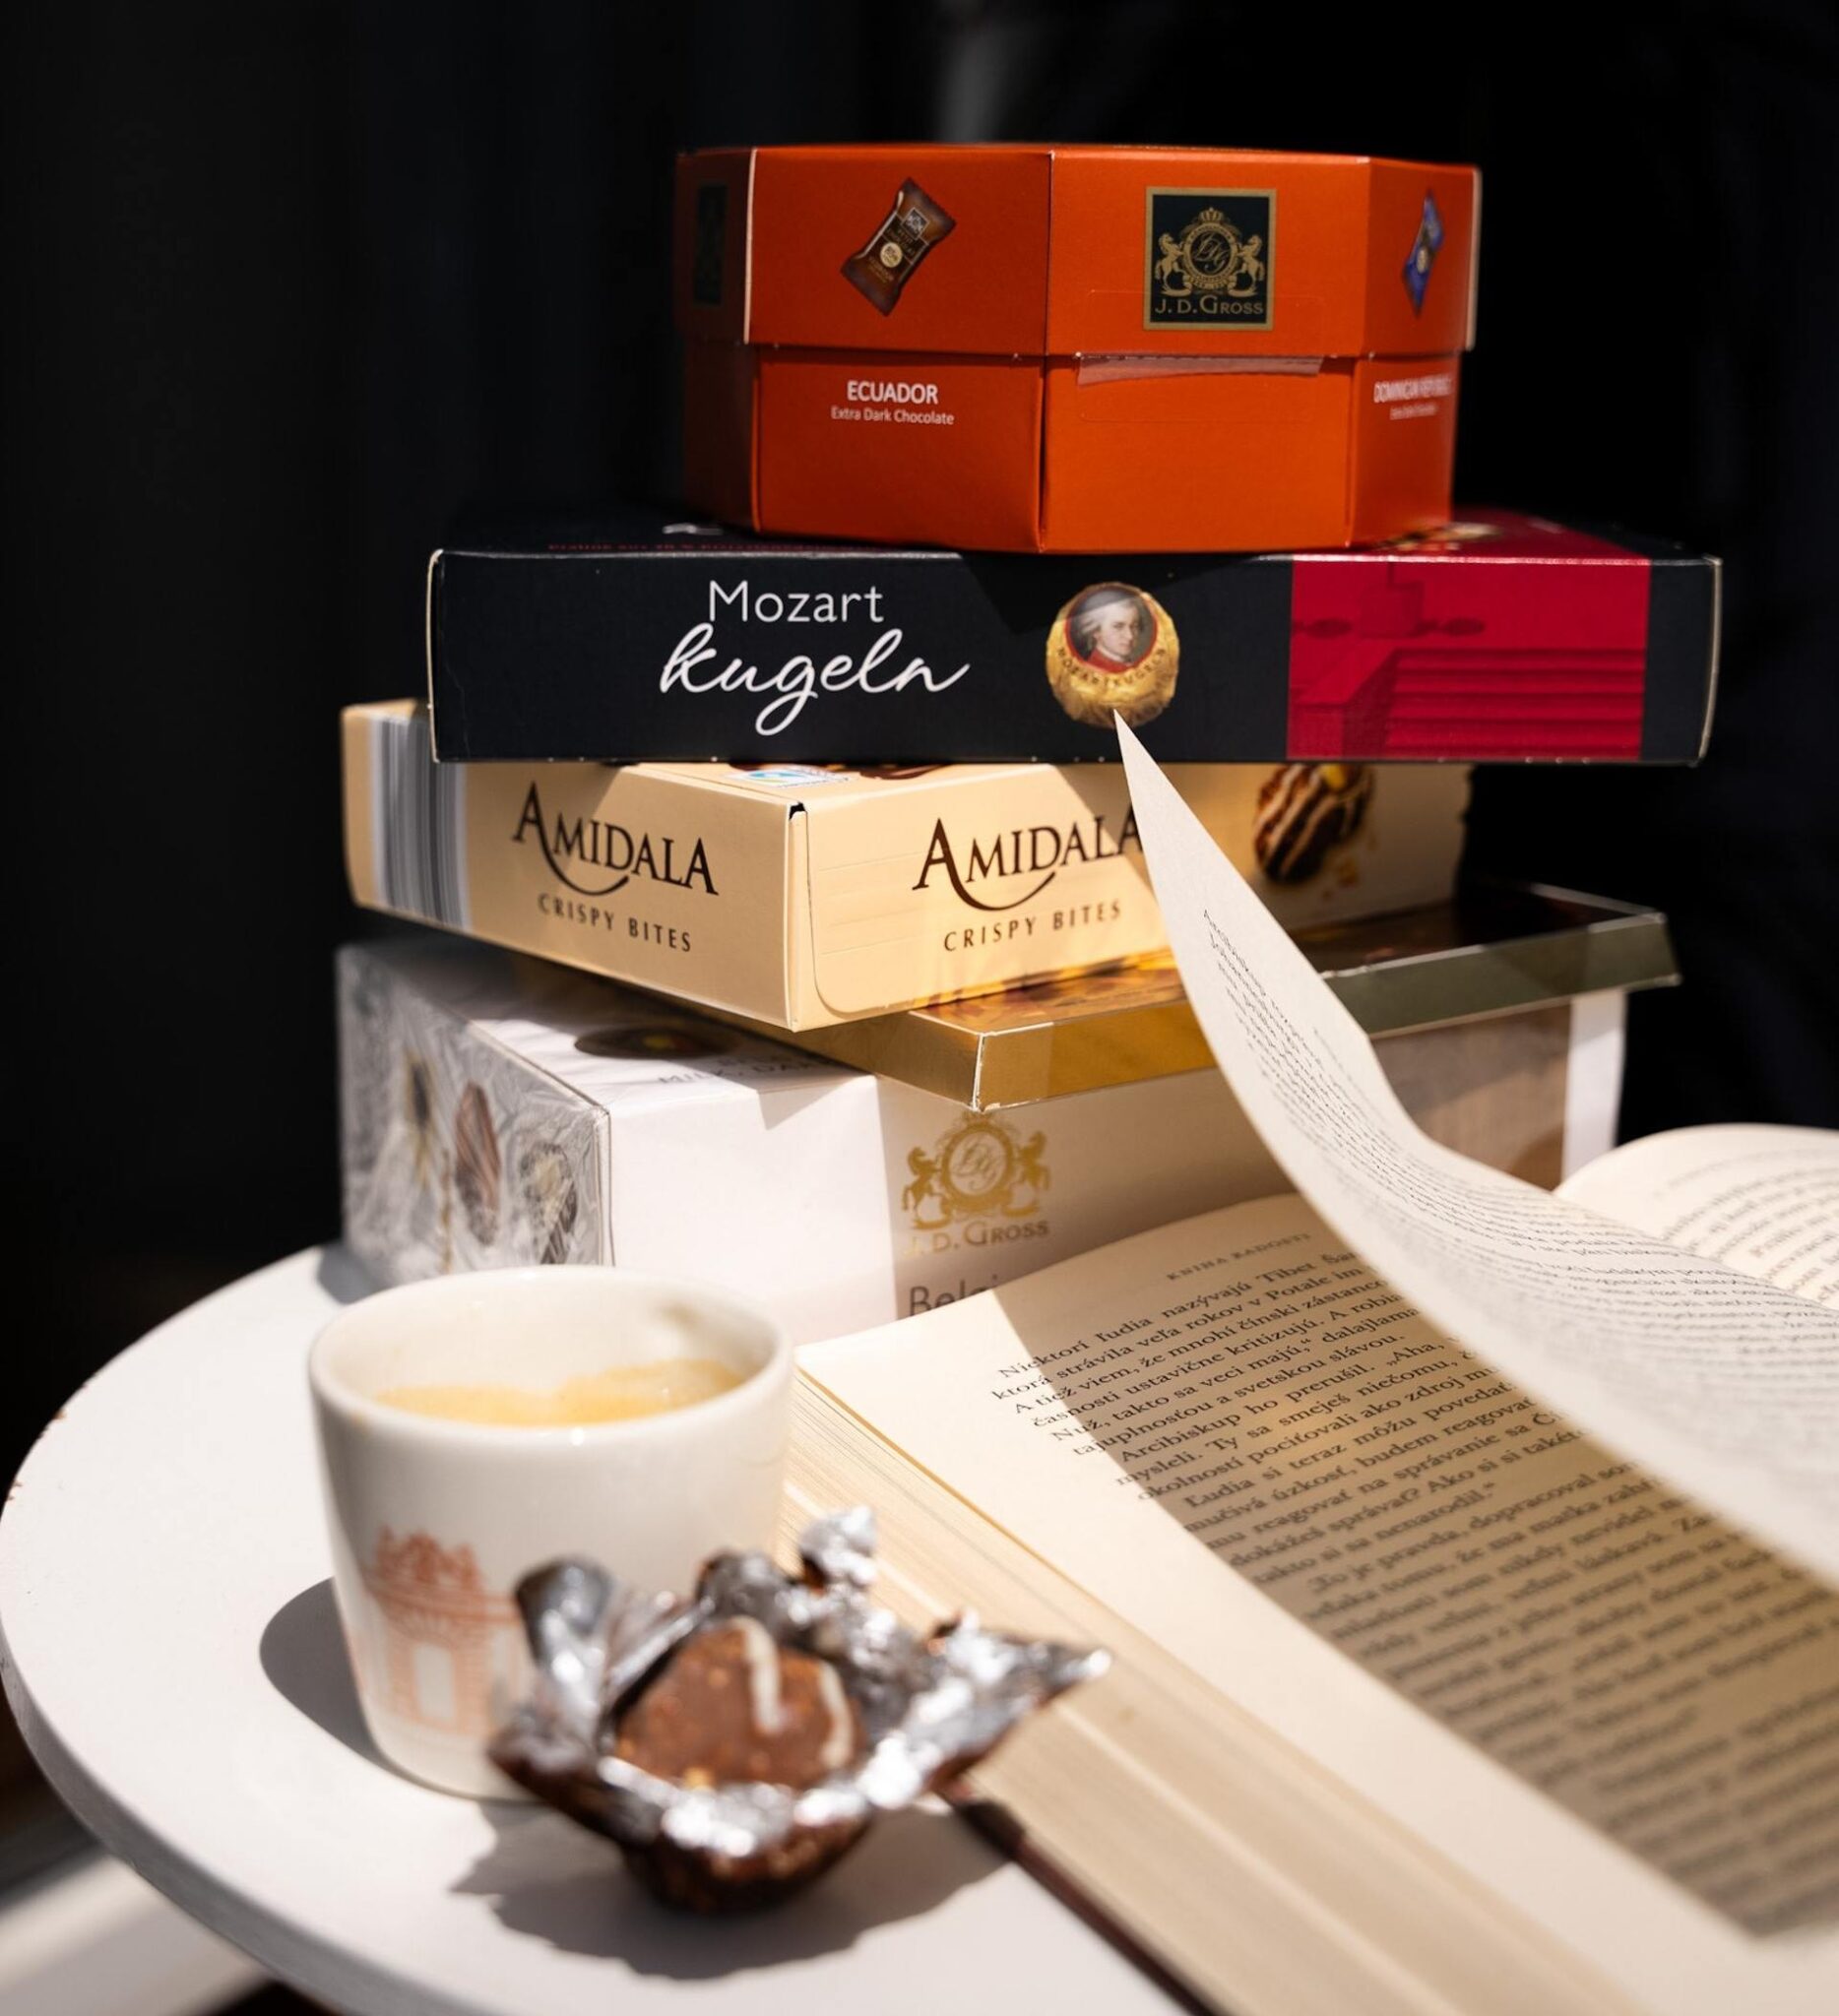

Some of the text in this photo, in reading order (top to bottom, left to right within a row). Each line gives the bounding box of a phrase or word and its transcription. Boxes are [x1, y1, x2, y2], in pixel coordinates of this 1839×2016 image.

[831, 406, 955, 425] Extra Dark Chocolate
[847, 380, 939, 405] ECUADOR
[709, 580, 885, 623] Mozart
[660, 622, 971, 736] kugeln
[512, 781, 720, 897] AMIDALA
[538, 892, 691, 953] CRISPY BITES
[943, 899, 1121, 952] CRISPY BITES
[990, 1376, 1053, 1400] ktorá
[1055, 1346, 1135, 1379] strávila
[1135, 1327, 1182, 1347] veľa
[1184, 1302, 1243, 1330] rokov
[1263, 1276, 1332, 1301] Potale
[997, 1339, 1090, 1378] Niektorí
[1093, 1317, 1154, 1343] ľudia
[1160, 1280, 1253, 1319] nazývajú
[1253, 1262, 1316, 1283] Tibet
[1033, 1389, 1121, 1427] časnosti
[1123, 1353, 1226, 1395] ustavične
[1223, 1317, 1325, 1355] kritizujú.
[1034, 1384, 1078, 1406] tiež
[1077, 1367, 1140, 1390] viem,
[1138, 1354, 1167, 1368] že
[1167, 1324, 1237, 1357] mnohí
[1236, 1302, 1300, 1331] čínski
[1050, 1418, 1111, 1441] Nuž,
[1110, 1396, 1170, 1420] takto
[1198, 1364, 1245, 1387] veci
[1246, 1337, 1311, 1370] majú,“
[1072, 1401, 1214, 1455] tajuplnosťou
[1233, 1358, 1327, 1398] svetskou
[1327, 1334, 1405, 1362] slávou.
[1115, 1449, 1204, 1485] mysleli.
[1203, 1435, 1238, 1451] Ty
[1277, 1392, 1352, 1426] smeješ
[1356, 1359, 1458, 1397] niečomu,
[1120, 1343, 1445, 1463] Arcibiskup ho prerušil. „Aha,
[1137, 1455, 1245, 1500] okolností
[1245, 1412, 1359, 1465] pociťovali
[1359, 1399, 1402, 1418] ako
[1403, 1374, 1466, 1402] zdroj
